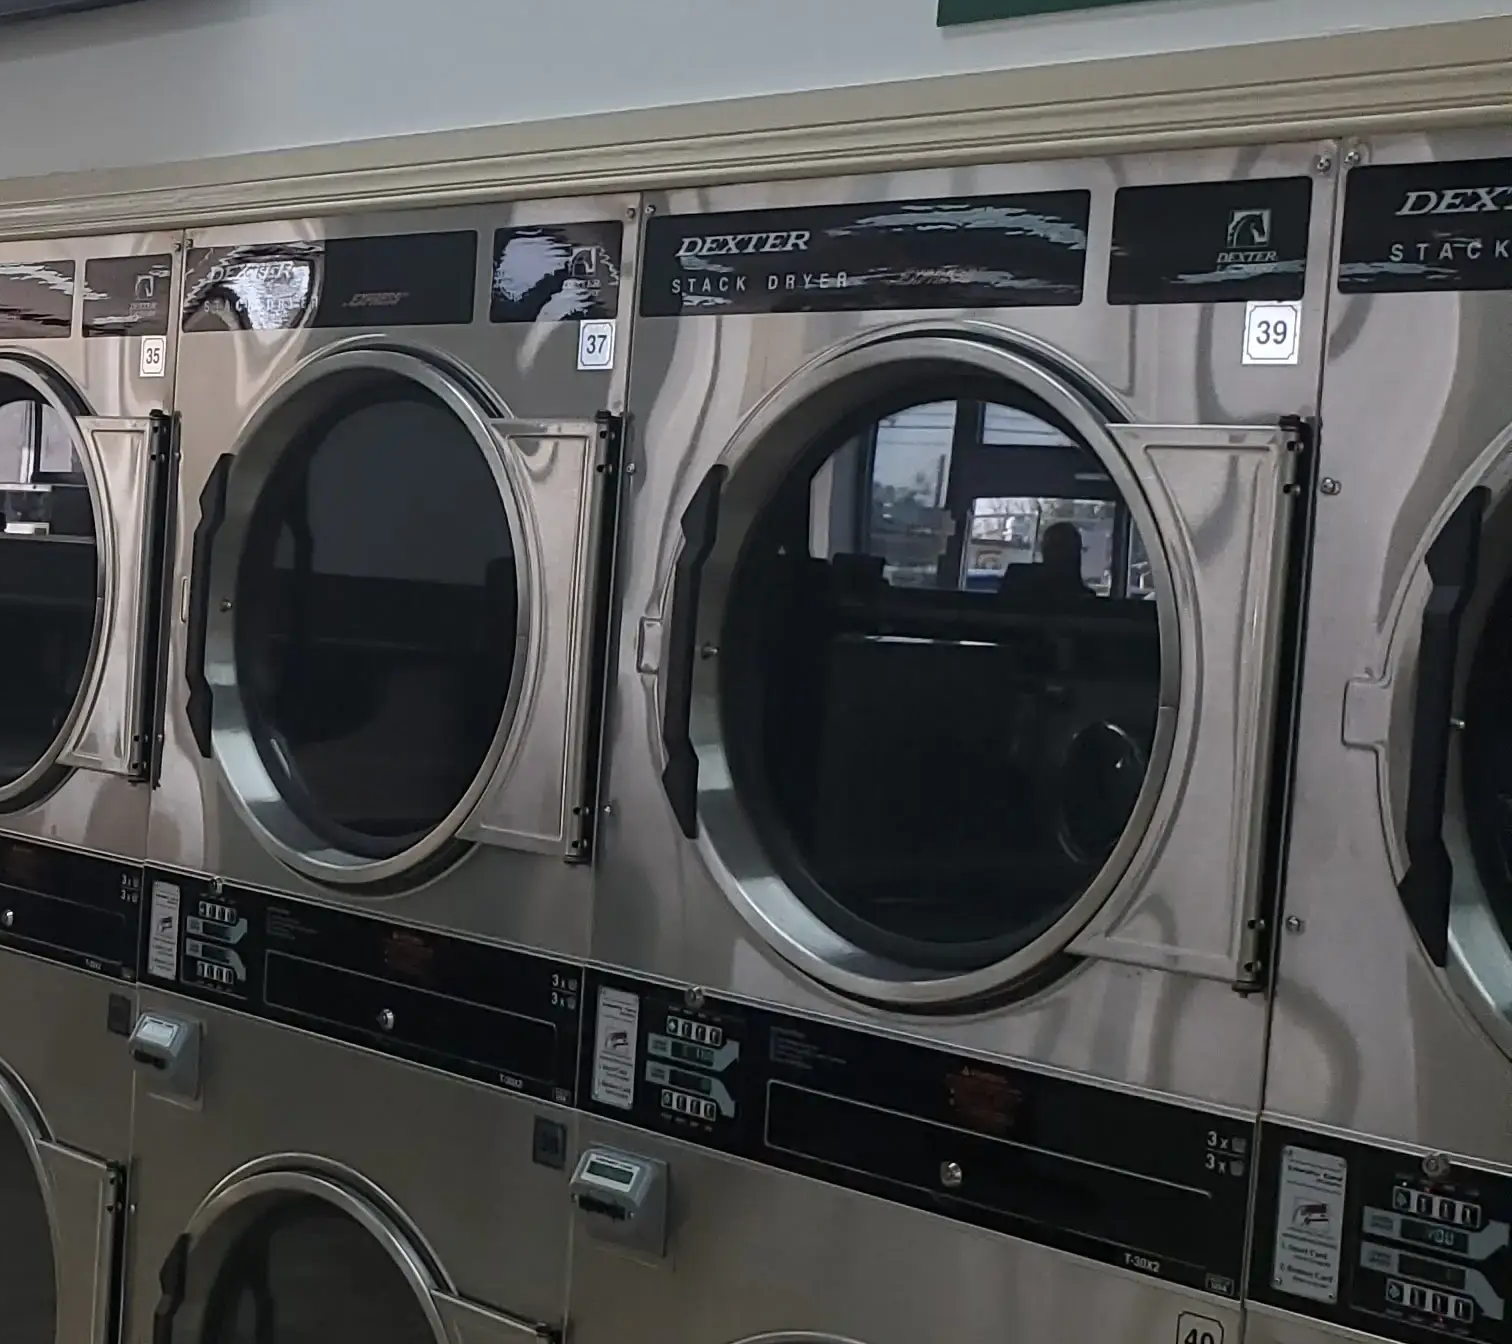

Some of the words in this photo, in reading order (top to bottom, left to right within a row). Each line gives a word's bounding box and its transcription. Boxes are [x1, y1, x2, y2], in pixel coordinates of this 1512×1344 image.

[675, 231, 811, 257] DEXTER
[1389, 239, 1510, 262] STACK
[1216, 250, 1278, 263] DEXTER
[672, 276, 746, 294] STACK
[768, 272, 849, 291] DRYER
[1256, 320, 1287, 345] 39
[586, 335, 607, 354] 37
[145, 347, 160, 364] 35
[1207, 1131, 1217, 1146] 3
[1205, 1154, 1215, 1169] 3
